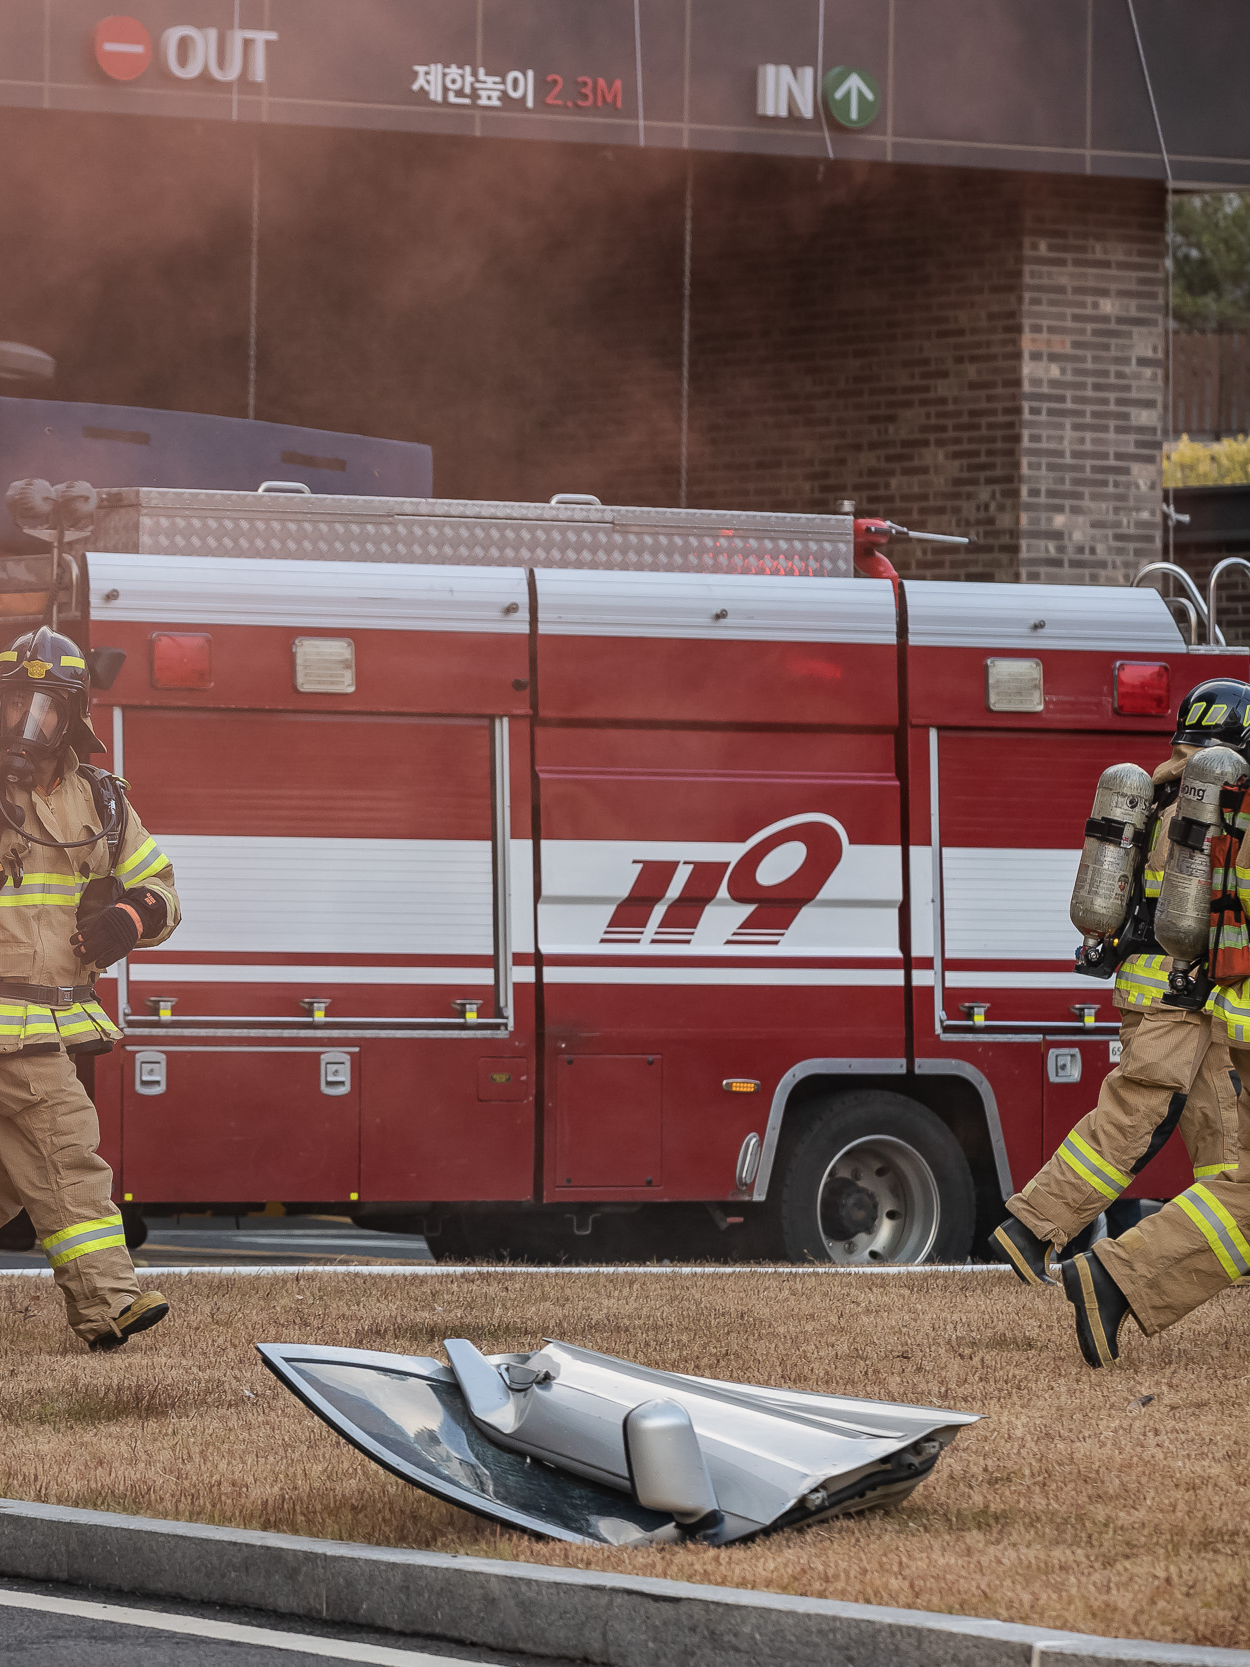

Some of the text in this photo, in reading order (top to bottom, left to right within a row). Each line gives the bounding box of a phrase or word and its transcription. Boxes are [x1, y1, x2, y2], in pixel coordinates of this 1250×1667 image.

[161, 25, 279, 82] OUT
[411, 63, 623, 109] 제한높이 2.3M
[757, 64, 814, 119] IN
[1181, 784, 1206, 801] ong
[599, 818, 844, 945] 119
